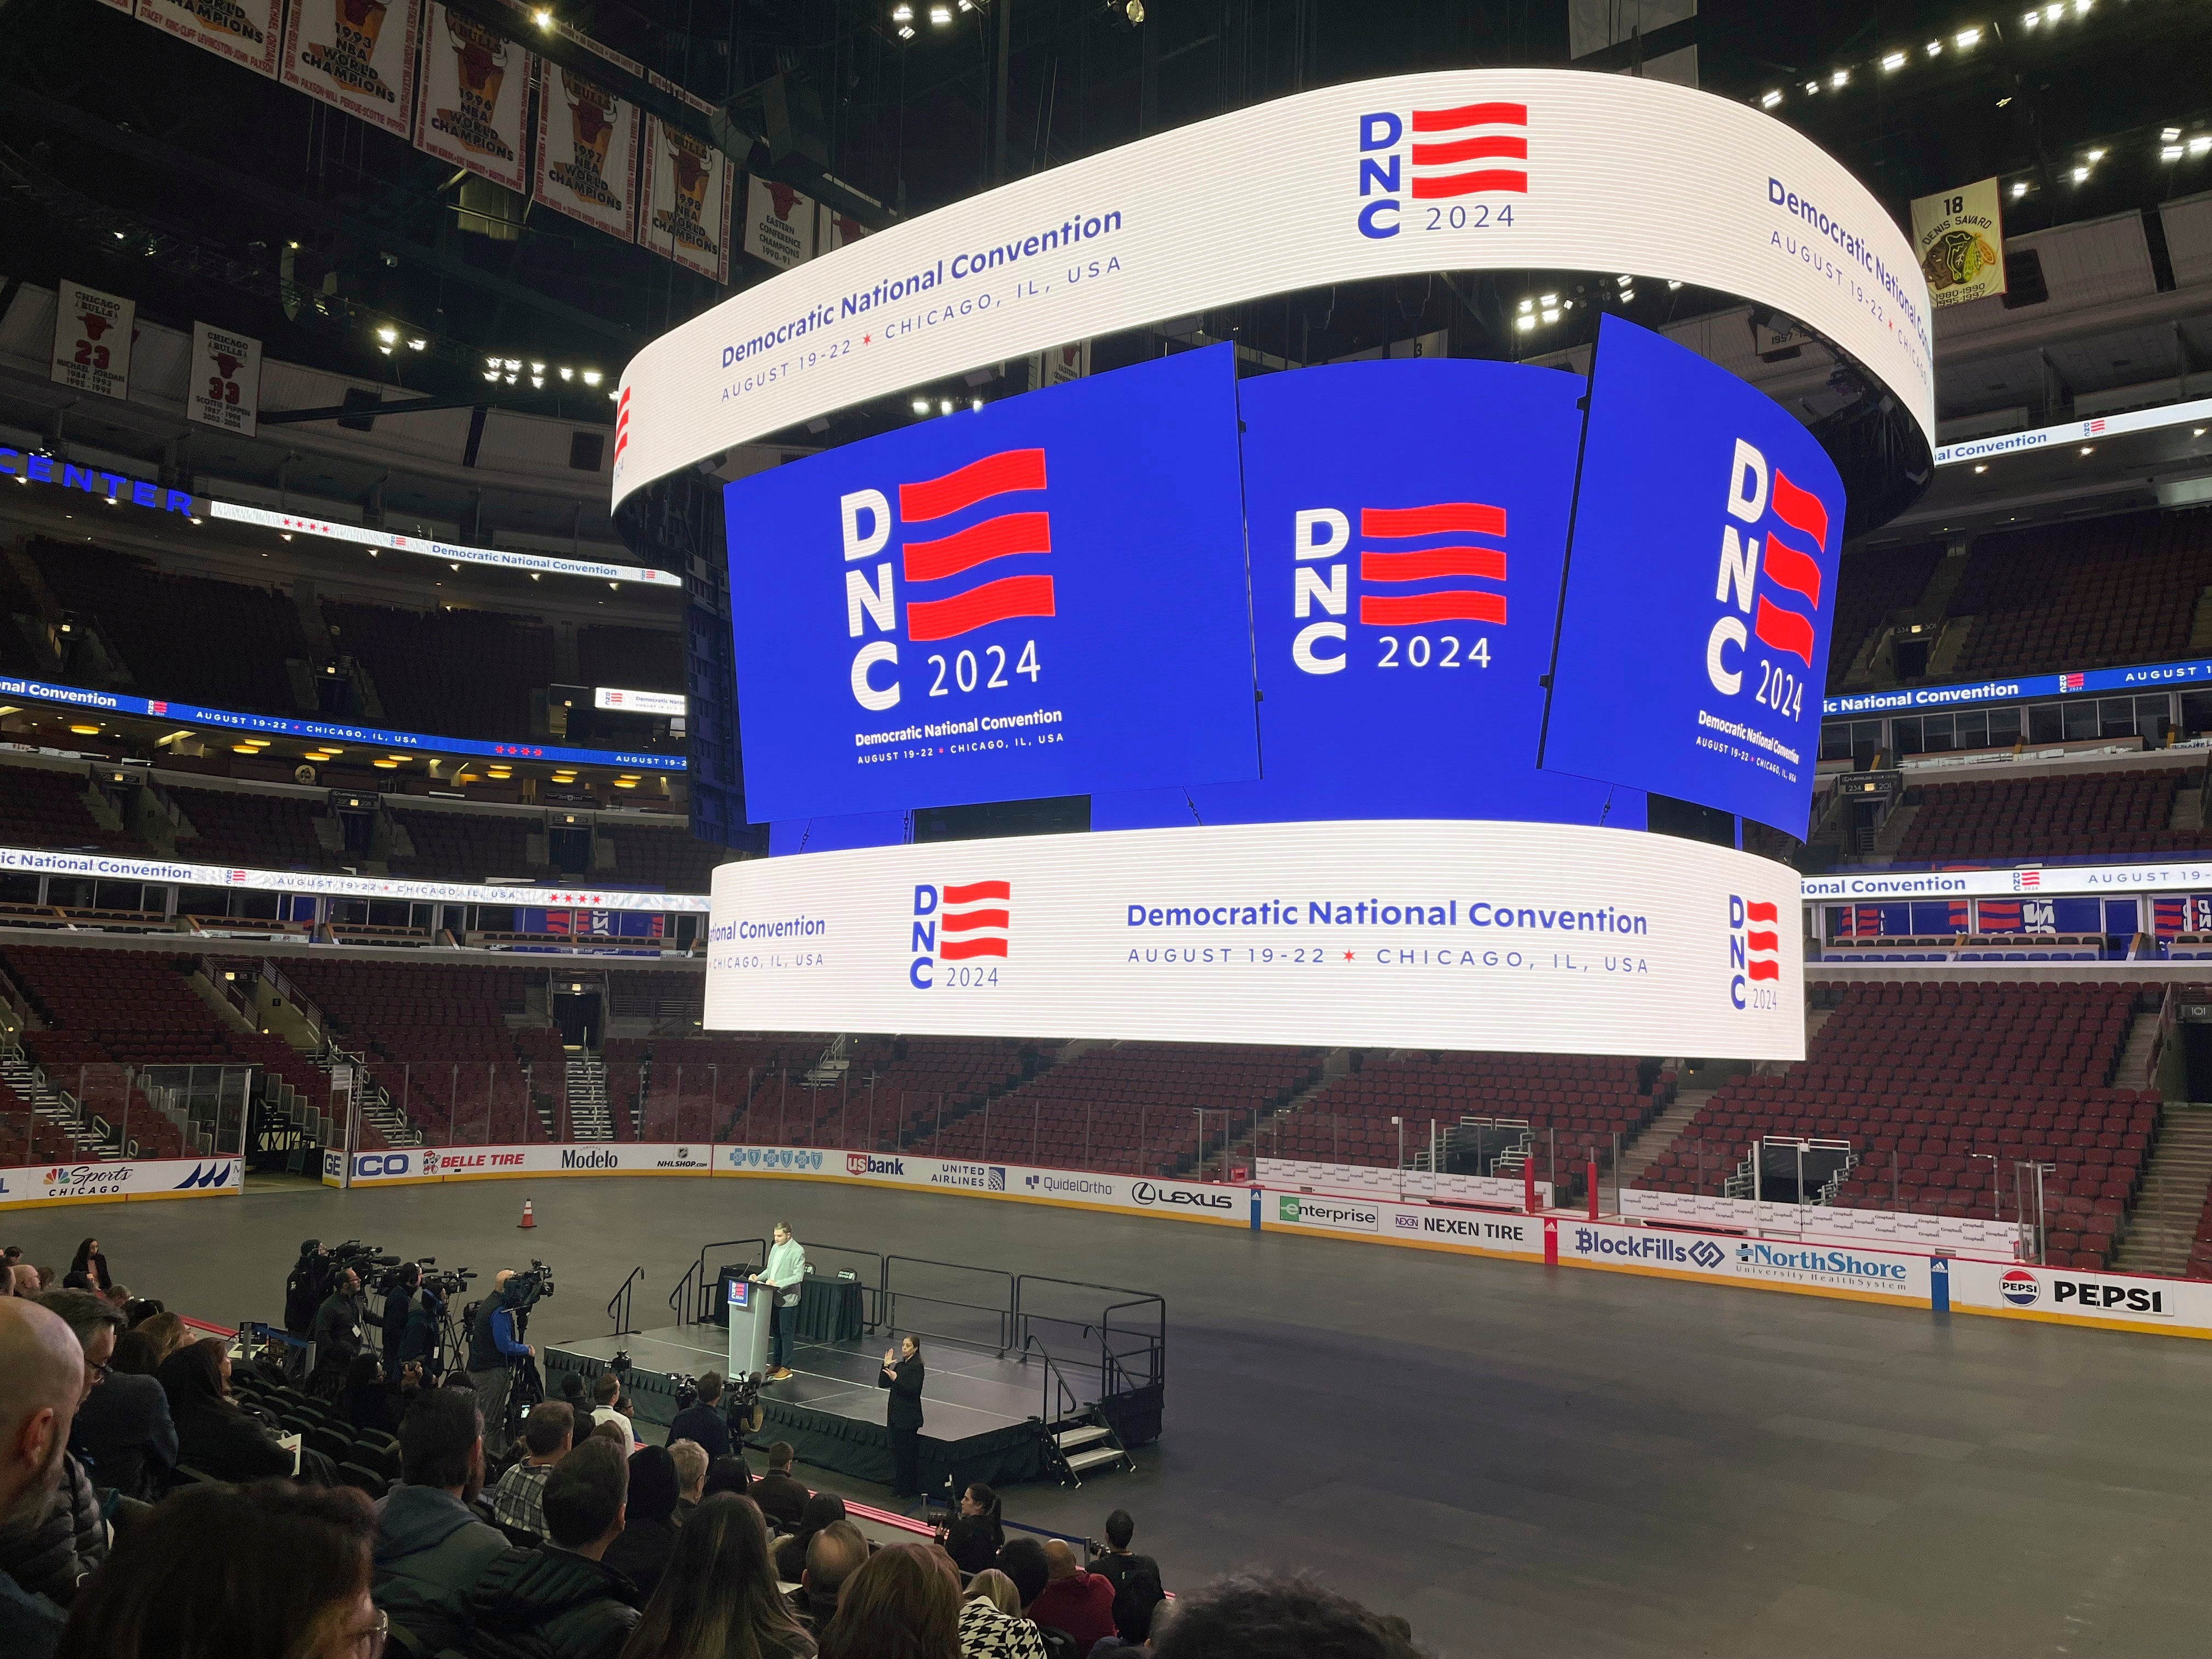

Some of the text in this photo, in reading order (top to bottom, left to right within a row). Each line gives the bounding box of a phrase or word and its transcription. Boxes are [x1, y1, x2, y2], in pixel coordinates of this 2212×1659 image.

[335, 20, 372, 49] 1993
[335, 37, 368, 62] NBA
[323, 45, 379, 80] WORLD
[302, 52, 396, 103] CHAMPIONS
[459, 87, 493, 111] 1996
[460, 101, 489, 124] NBA
[450, 109, 500, 142] WORLD
[431, 117, 515, 162] CHAMPIONS
[573, 140, 603, 163] 1997
[565, 162, 609, 191] WORLD
[574, 155, 600, 175] NBA
[1358, 111, 1403, 239] DNC
[548, 168, 622, 211] CHAMPIONS
[676, 202, 698, 222] NBA
[1426, 205, 1515, 231] 2024
[1944, 195, 1963, 216] 18
[652, 217, 718, 255] CHAMPIONS
[667, 211, 706, 238] WORLD
[759, 223, 802, 250] CONFERENCE
[766, 215, 795, 235] EASTERN
[1922, 215, 1992, 246] DENIS SAVARD
[759, 234, 800, 259] CHAMPIONS
[762, 245, 791, 266] 1990-91
[1768, 176, 1917, 328] Democratic National
[721, 208, 1124, 369] Democratic National Convention
[1770, 230, 1883, 323] AUGUST 19-22
[75, 291, 120, 312] CHICAGO
[1936, 282, 1985, 301] 1980-1990
[81, 302, 114, 317] BULLS
[207, 331, 249, 351] CHICAGO
[721, 256, 1122, 402] AUGUST 19-22 CHICAGO, IL, USA
[75, 340, 110, 370] 23
[213, 341, 241, 357] BULLS
[57, 358, 125, 383] MICHAEL JORDAN
[208, 376, 240, 405] 33
[196, 395, 251, 417] SCOTTIE PIPPEN
[1955, 433, 2047, 458] Convention
[0, 447, 192, 518] CENTER
[432, 544, 617, 576] Democratic National Convention
[1707, 437, 1768, 696] DNC
[840, 488, 901, 712] DNC
[1293, 508, 1350, 675] DNC
[1378, 635, 1492, 668] 2024
[927, 640, 1041, 697] 2024
[2124, 666, 2197, 682] AUGUST
[29, 684, 117, 708] Convention
[1756, 659, 1803, 722] 2024
[2059, 674, 2068, 693] DNC
[1841, 692, 1912, 712] National
[1915, 683, 2019, 704] Convention
[196, 711, 417, 744] AUGUST 19-22 CHICAGO, IL, USA
[855, 709, 1063, 747] Democratic National Convention
[1699, 709, 1799, 765] Democratic National Convention
[616, 755, 660, 766] AUGUST
[857, 732, 1064, 765] AUGUST 19-22 CHICAGO, IL, USA
[1696, 736, 1797, 784] AUGUST 19-22 CHICAGO, USA
[20, 855, 93, 871] National
[98, 860, 192, 879] Convention
[2088, 871, 2170, 884] AUGUST
[278, 876, 516, 899] AUGUST 19-22 CHICAGO, IL, USA
[1850, 876, 1966, 894] Convention
[2013, 872, 2021, 892] DNC
[738, 915, 826, 940] Convention
[1127, 899, 1648, 936] Democratic National Convention
[909, 884, 938, 990] DNC
[713, 953, 824, 970] CHICAGO, IL, USA
[1127, 947, 1649, 974] AUGUST 19-22 CHICAGO, IL, USA
[1729, 894, 1747, 1012] DNC
[946, 966, 1000, 989] 2024
[1752, 987, 1778, 1012] 2024
[2191, 1007, 2206, 1016] 101
[441, 1153, 525, 1169] BELLE TIRE
[561, 1149, 618, 1169] Modelo
[943, 1164, 985, 1176] UNITED
[71, 1166, 133, 1187] Sports
[931, 1173, 985, 1187] AIRLINES
[1043, 1177, 1112, 1195] QuidelOrtho
[48, 1185, 120, 1197] CHICAGO
[1159, 1189, 1232, 1209] LEXUS
[1285, 1200, 1376, 1224] enterprise
[1424, 1217, 1523, 1242] NEXEN TIRE
[1575, 1227, 1687, 1262] BlockFills
[1754, 1243, 1907, 1280] NorthShore
[1736, 1266, 1906, 1290] University HealthSystem
[2002, 1282, 2038, 1294] PEPSI
[2053, 1280, 2162, 1313] PEPSI
